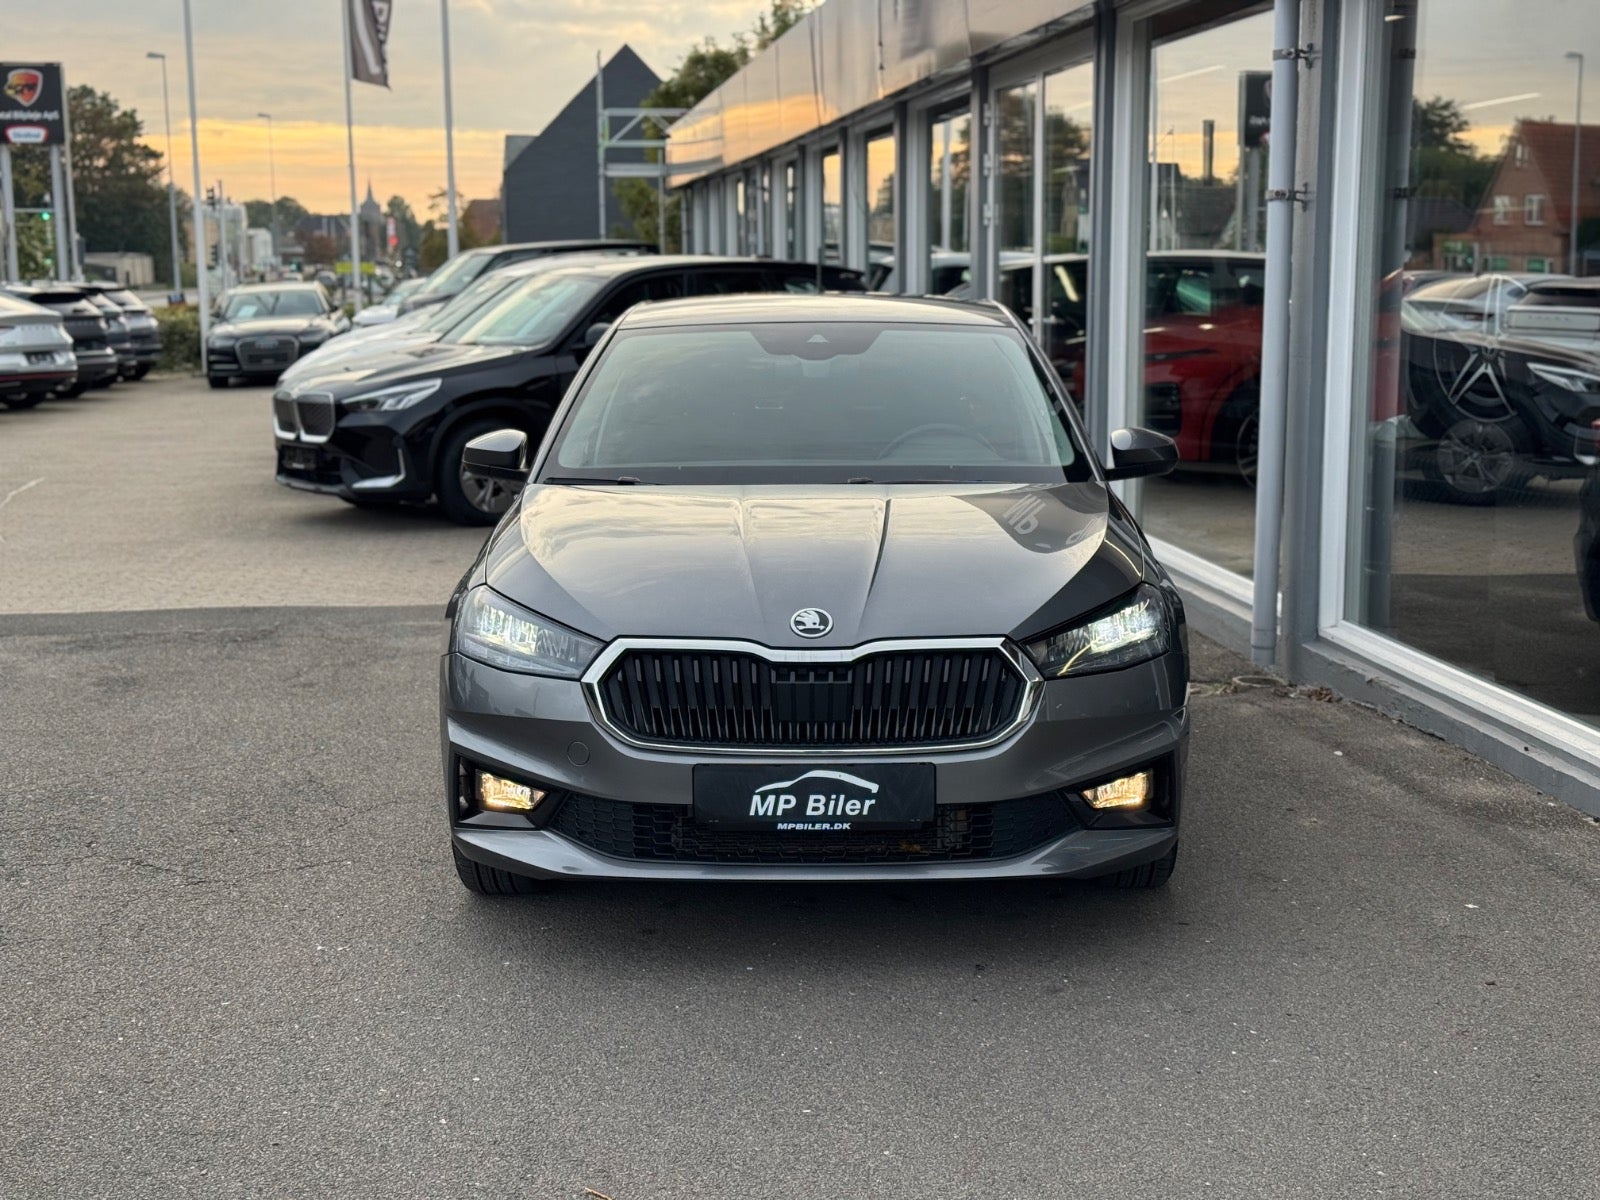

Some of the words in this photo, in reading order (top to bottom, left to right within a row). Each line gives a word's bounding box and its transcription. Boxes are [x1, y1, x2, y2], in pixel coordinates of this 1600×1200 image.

[749, 794, 797, 816] MP
[806, 794, 876, 816] Biler
[777, 822, 852, 831] MPBILER.DK
